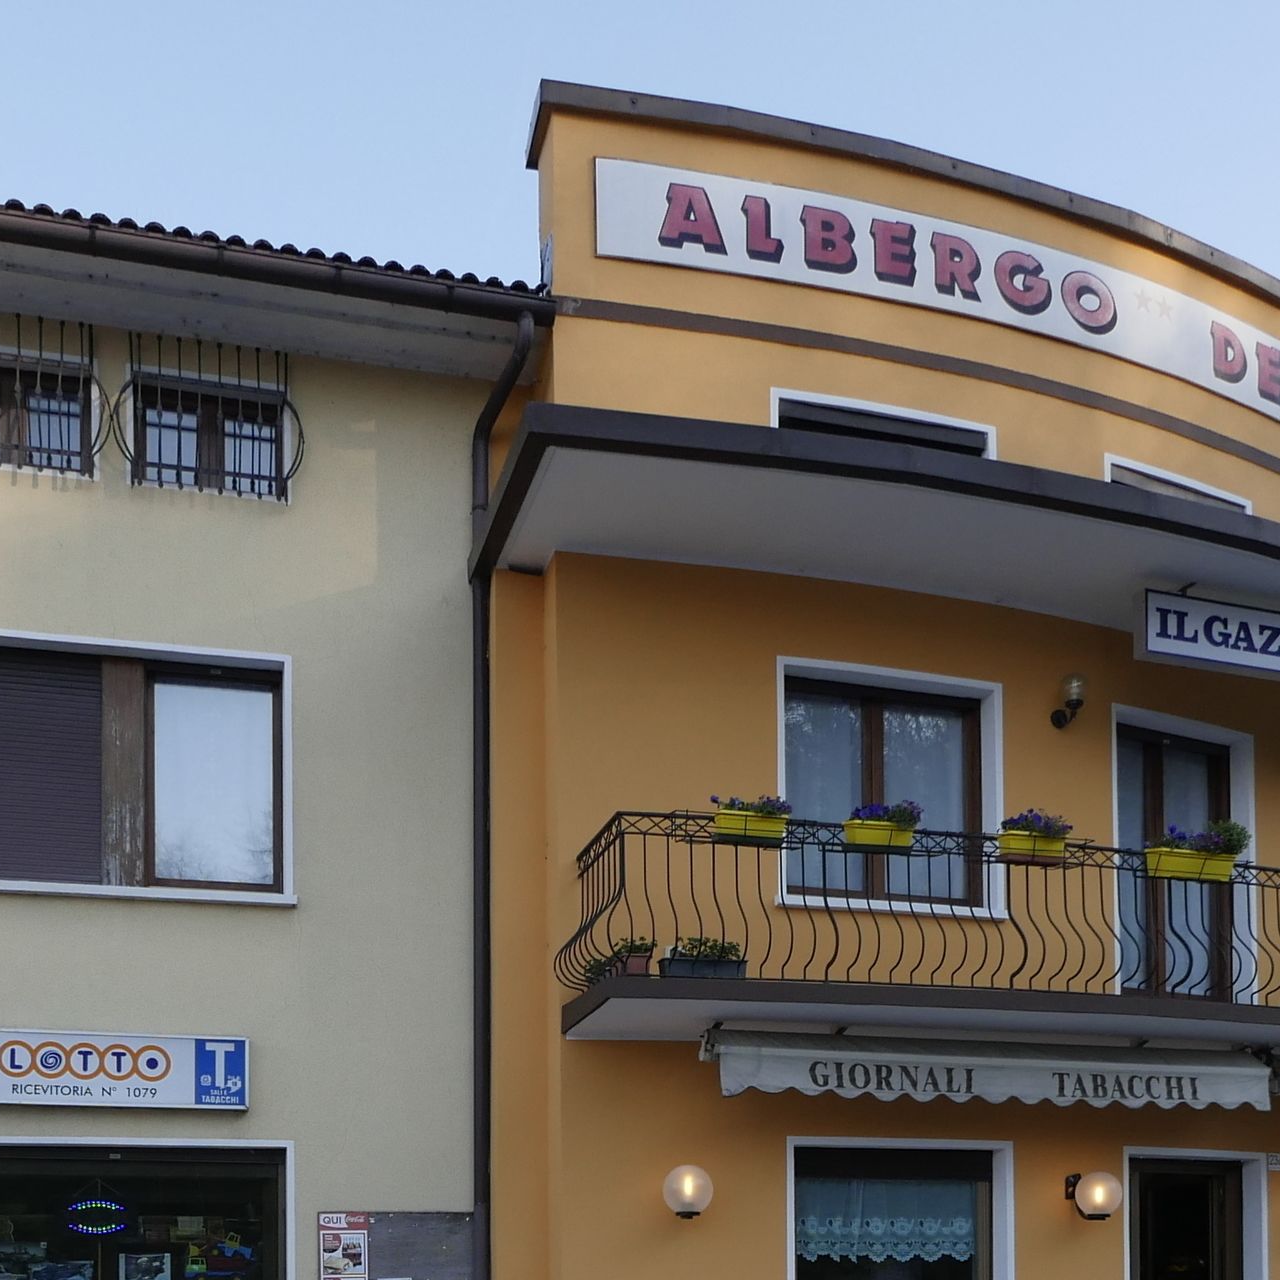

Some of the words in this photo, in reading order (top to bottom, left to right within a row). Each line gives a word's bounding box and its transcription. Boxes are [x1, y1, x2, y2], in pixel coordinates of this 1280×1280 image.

[658, 182, 1119, 336] ALBERGO
[1155, 606, 1199, 644] IL
[1, 1043, 166, 1078] LOTTO
[205, 1042, 235, 1089] T
[11, 1084, 93, 1097] RICEVITORIA
[126, 1087, 158, 1099] 1079
[808, 1061, 976, 1095] GIORNALI
[1052, 1071, 1200, 1101] TABACCHI
[322, 1215, 342, 1225] QUI
